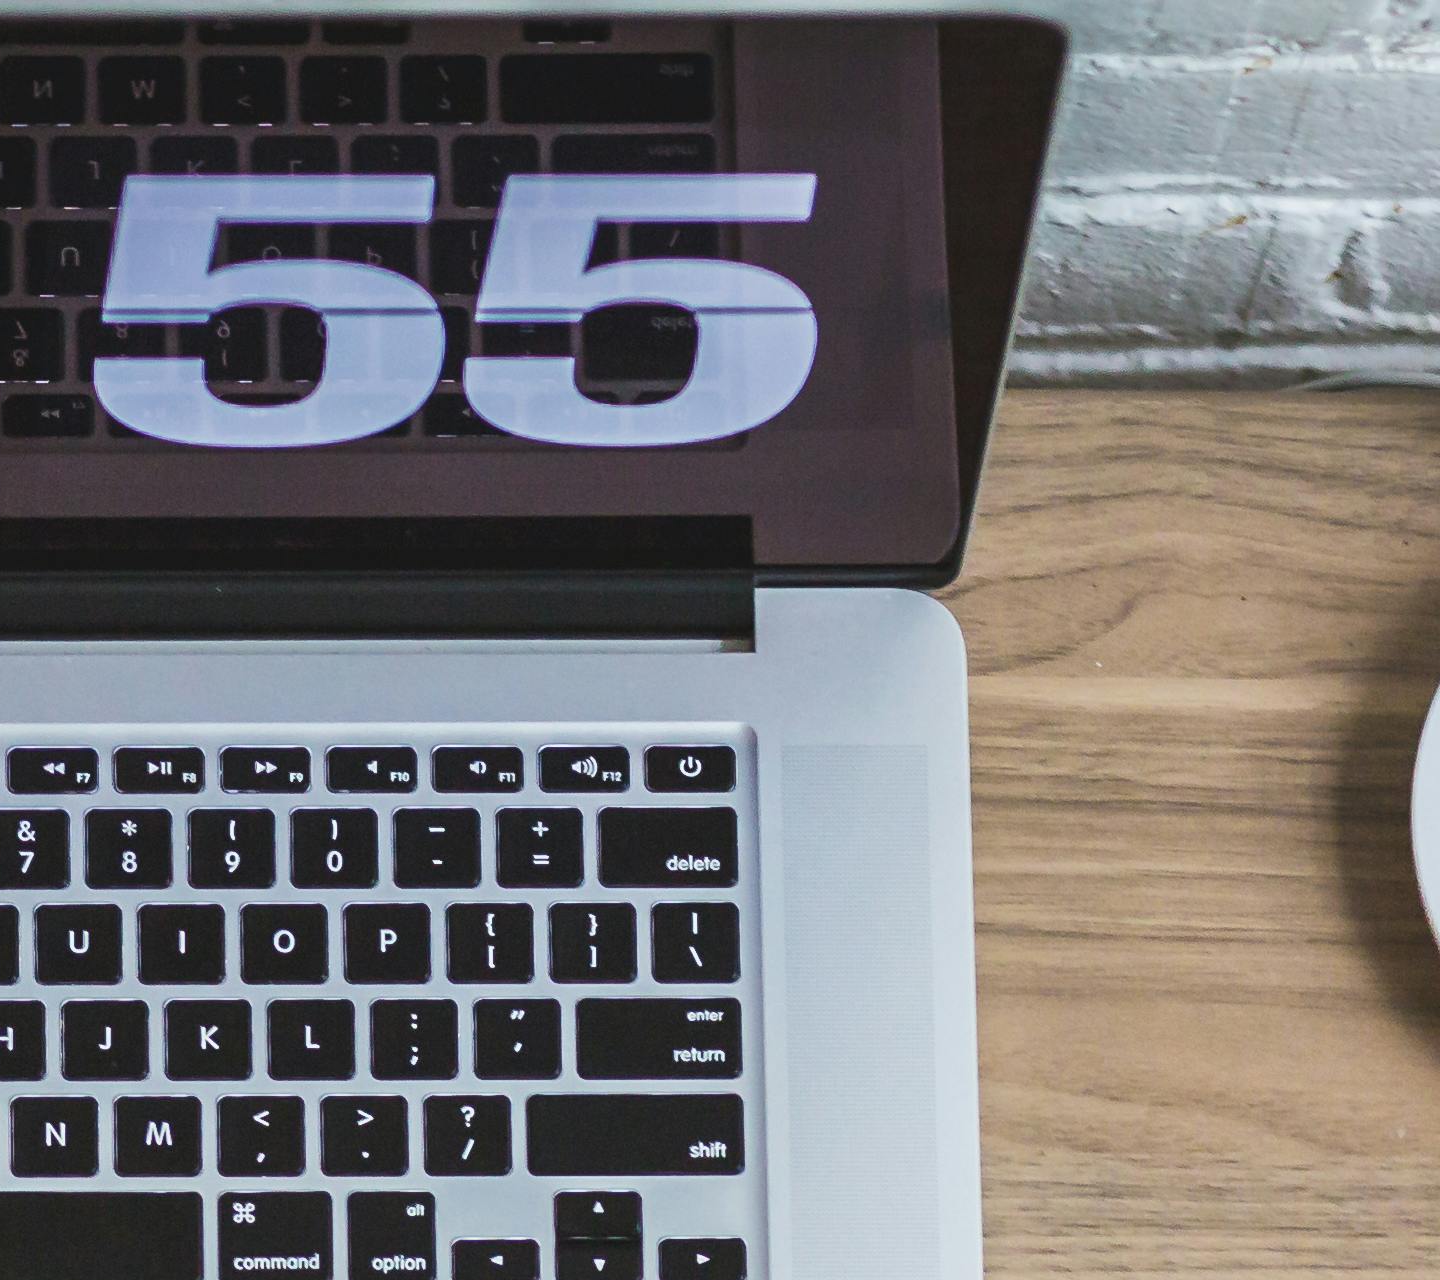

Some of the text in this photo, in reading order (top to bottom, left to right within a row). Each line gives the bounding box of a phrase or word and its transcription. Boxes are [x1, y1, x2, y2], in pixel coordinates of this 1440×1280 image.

[92, 172, 819, 448] 55
[18, 850, 35, 874] 7
[121, 850, 138, 874] 8
[224, 850, 241, 873] 9
[326, 850, 344, 873] 0
[665, 854, 721, 872] delete
[68, 930, 90, 954] U
[178, 930, 186, 954] I
[273, 929, 296, 954] O
[379, 928, 398, 953] P
[686, 1009, 724, 1022] enter
[98, 1026, 112, 1051] J
[200, 1025, 220, 1050] K
[304, 1025, 321, 1050] L
[673, 1047, 726, 1063] return
[45, 1122, 67, 1147] N
[145, 1121, 173, 1146] M
[689, 1141, 727, 1159] shift
[406, 1203, 425, 1217] alt
[233, 1252, 320, 1271] command
[371, 1254, 427, 1275] option
